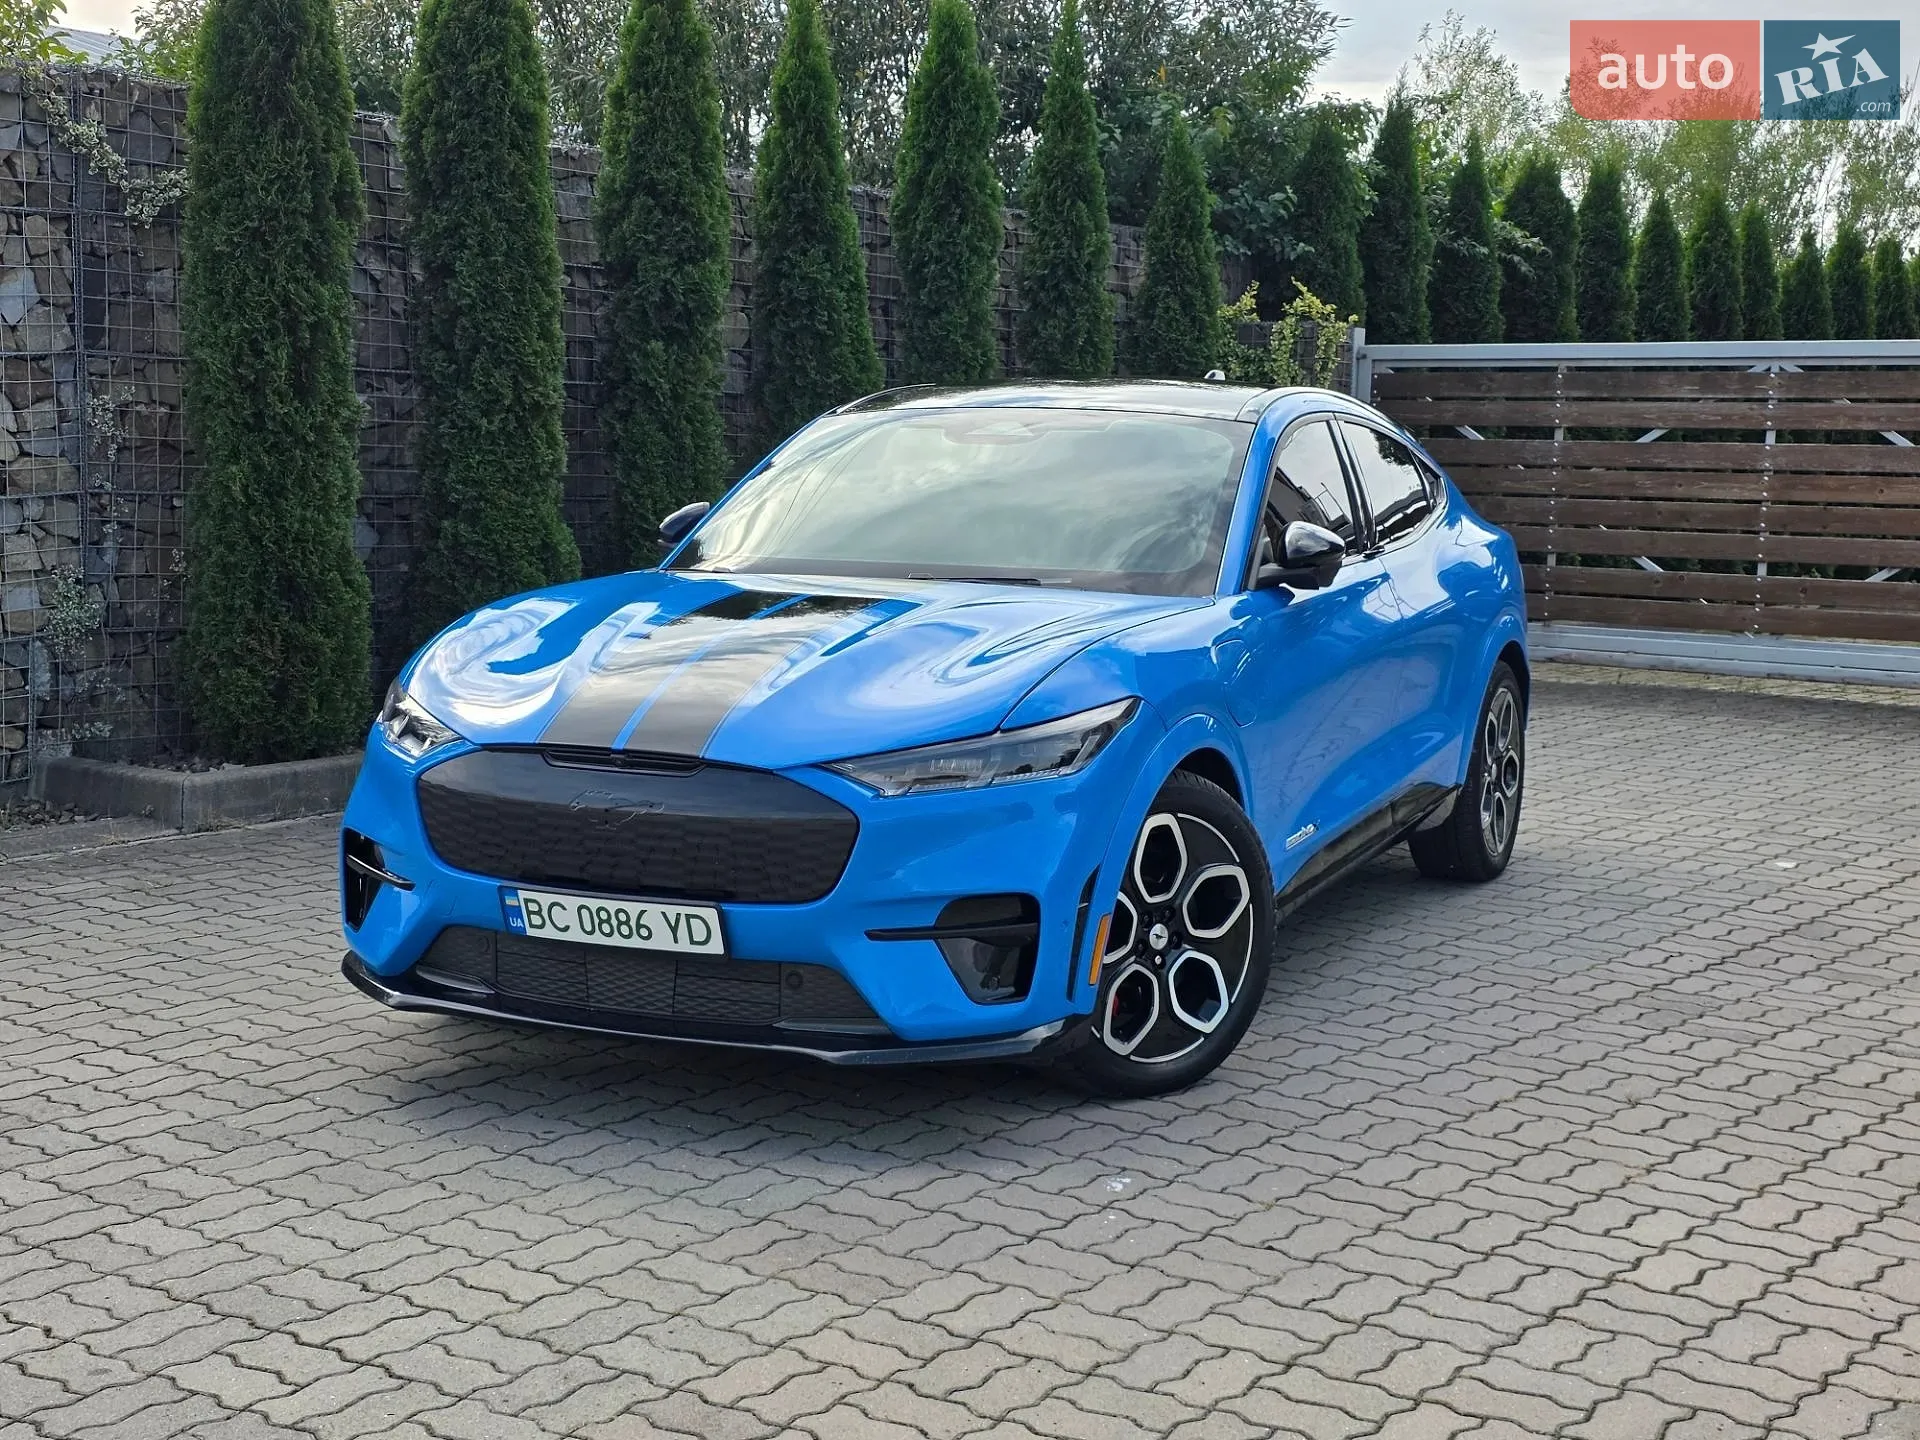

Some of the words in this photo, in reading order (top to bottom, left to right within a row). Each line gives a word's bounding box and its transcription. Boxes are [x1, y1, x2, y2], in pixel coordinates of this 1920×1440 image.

[509, 916, 525, 928] UA
[523, 897, 571, 933] BC
[577, 904, 653, 941] 0886
[661, 910, 712, 947] YD
